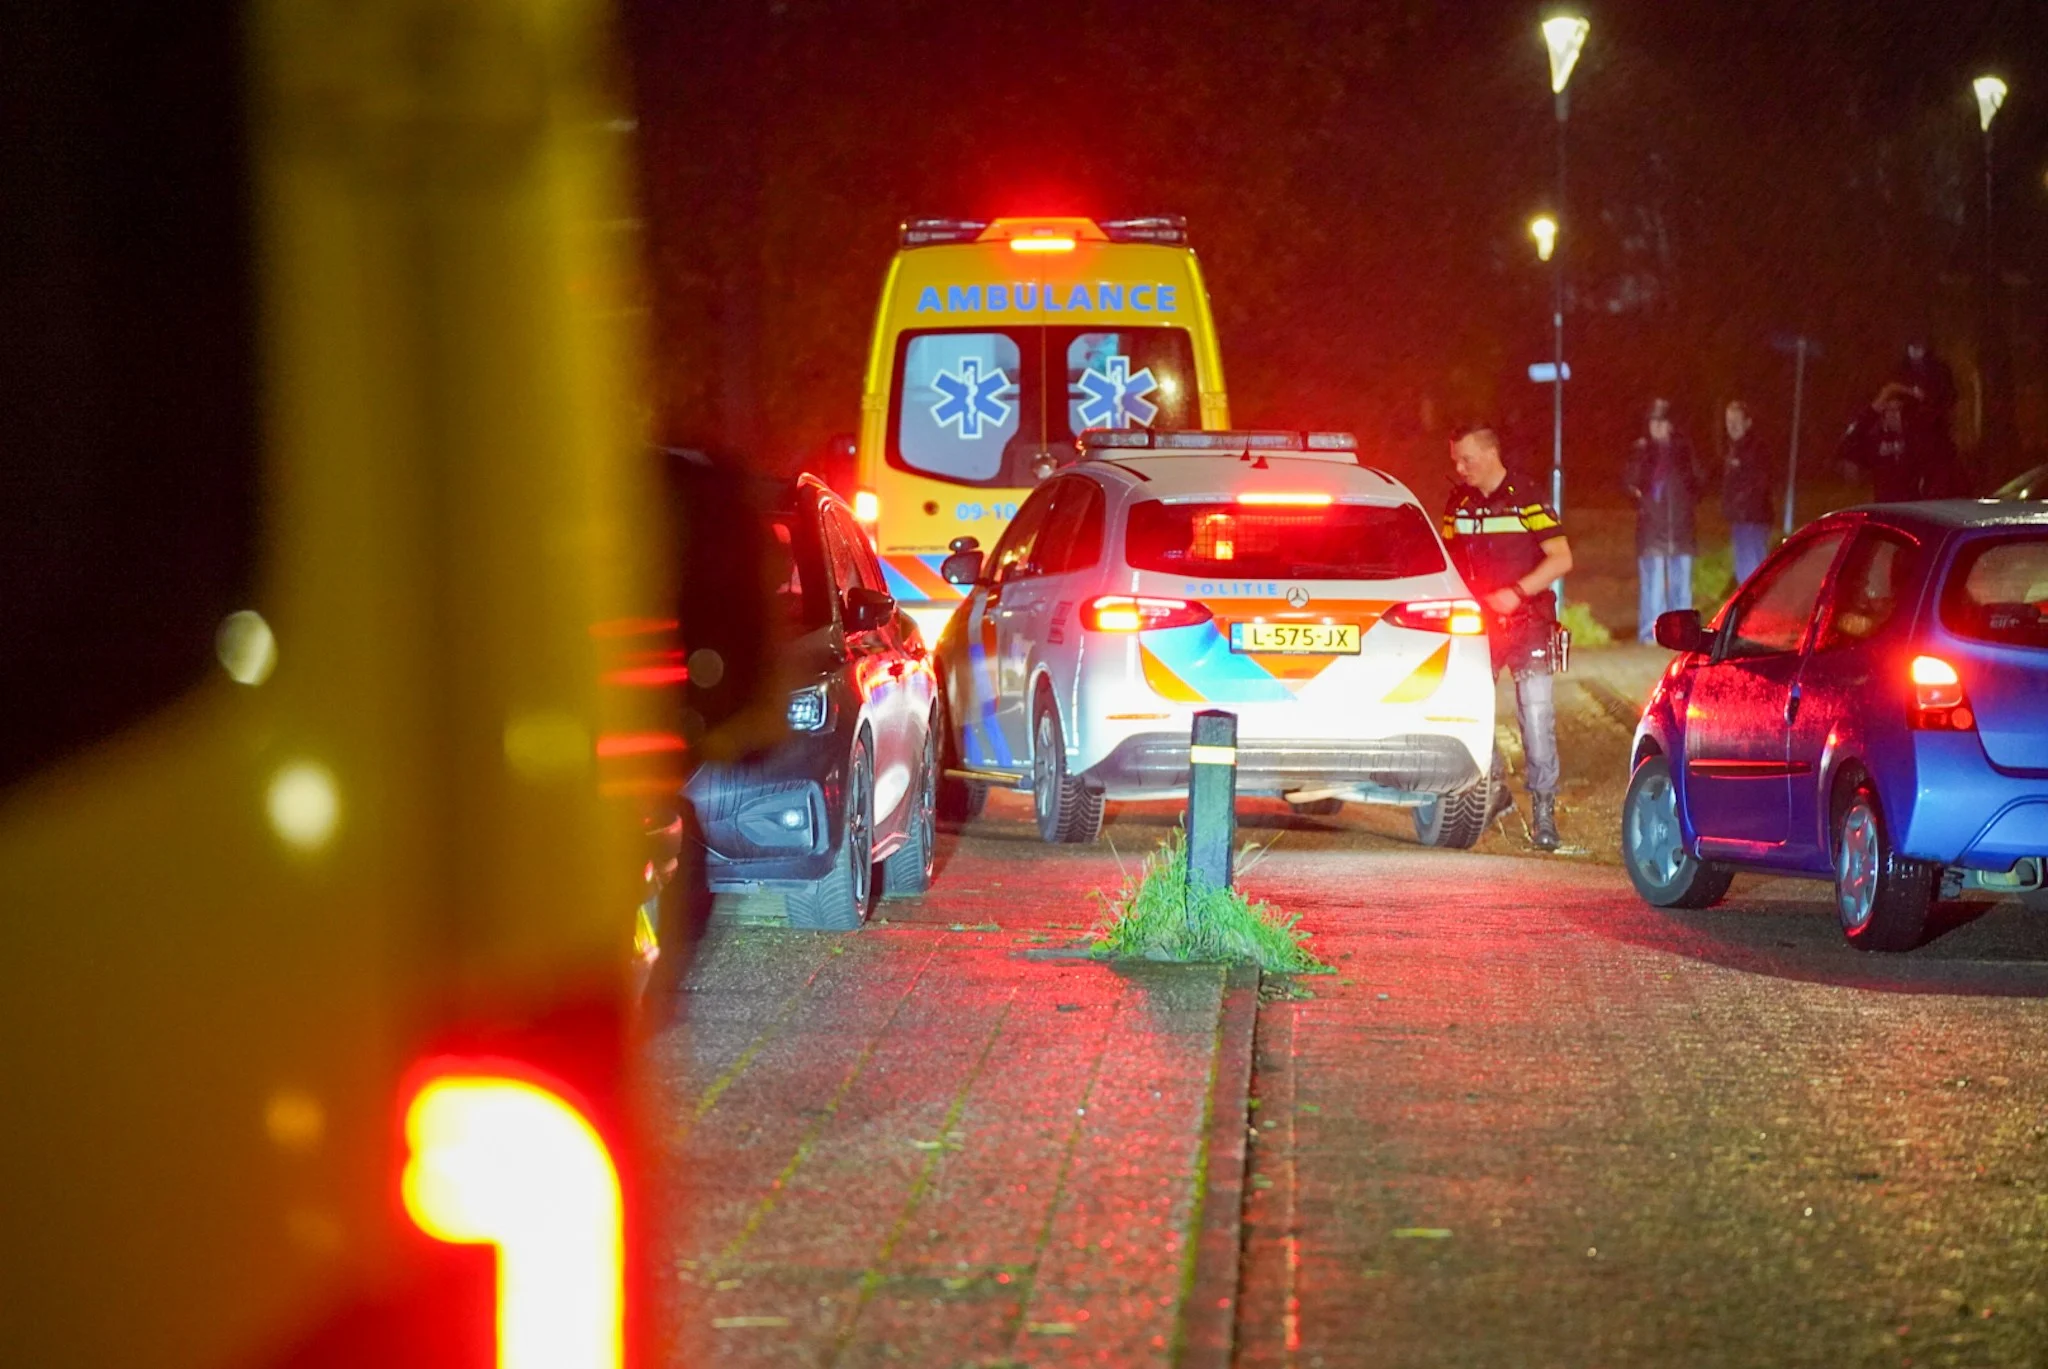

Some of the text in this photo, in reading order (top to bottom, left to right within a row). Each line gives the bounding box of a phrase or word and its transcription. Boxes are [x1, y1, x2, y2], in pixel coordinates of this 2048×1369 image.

[915, 285, 1178, 312] AMBULANCE
[1185, 583, 1279, 595] POLITIE
[1253, 628, 1349, 647] L-575-JX
